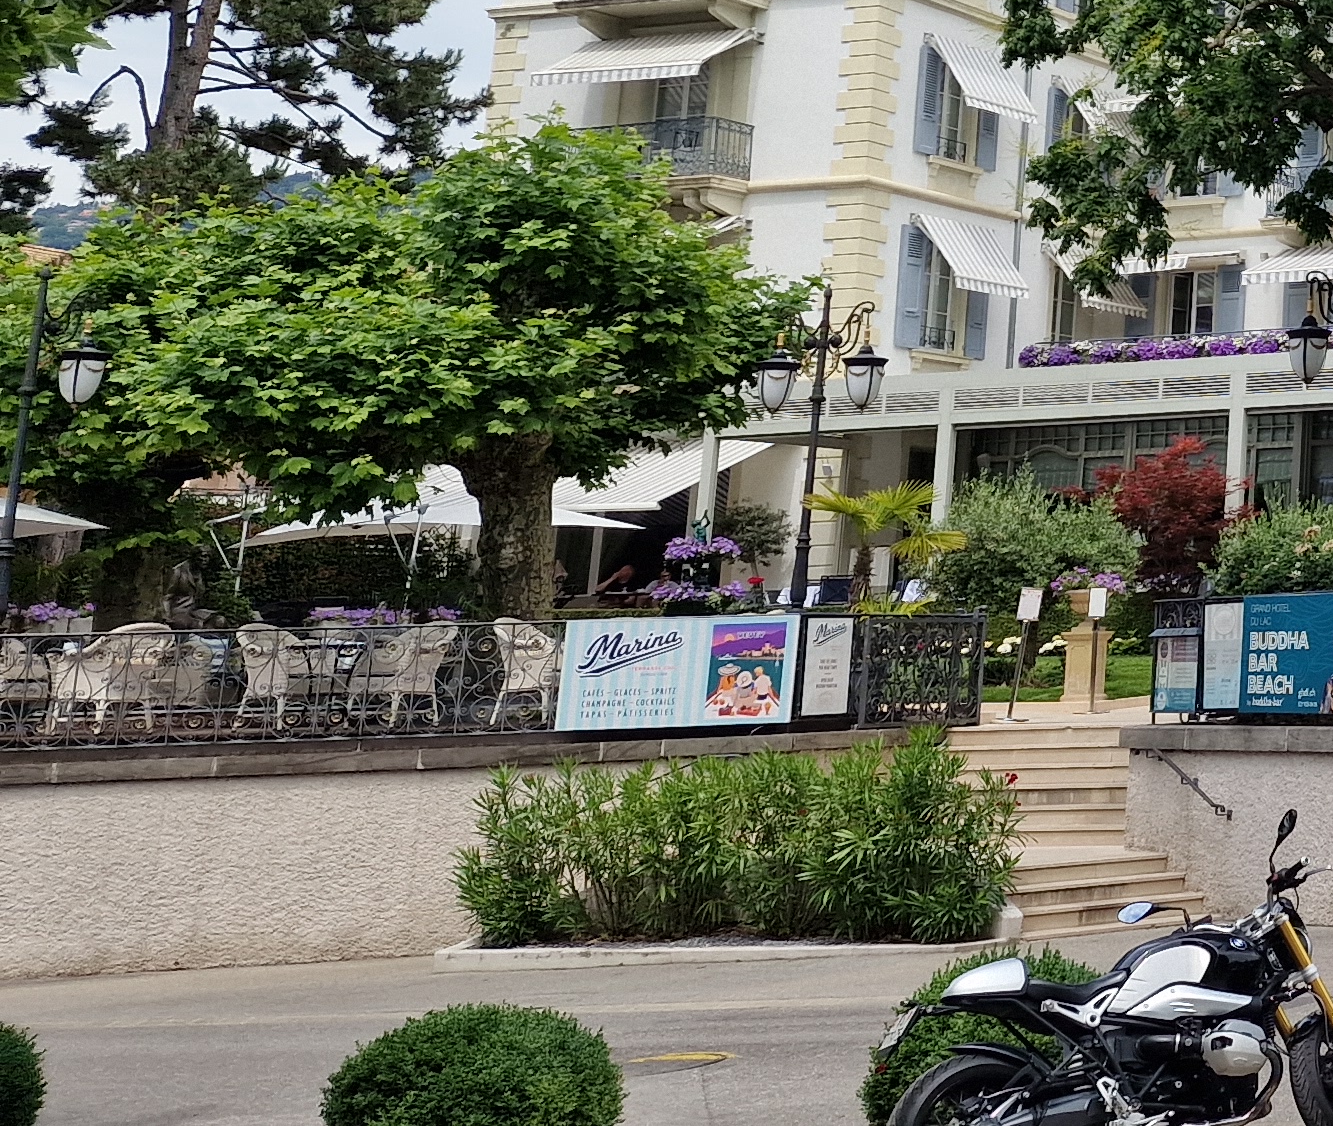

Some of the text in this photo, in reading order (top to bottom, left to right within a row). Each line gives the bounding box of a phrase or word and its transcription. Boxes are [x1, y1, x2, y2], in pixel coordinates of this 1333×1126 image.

[1250, 603, 1291, 613] GRAND HOTEL
[1250, 616, 1272, 626] DU LAC
[1249, 631, 1310, 651] BUDDHA
[576, 631, 683, 674] Marina
[1248, 652, 1278, 672] BAR
[1247, 675, 1294, 694] BEACH
[613, 688, 641, 697] GLACES
[651, 687, 677, 696] SPRITZ
[581, 699, 626, 708] CHAMPAGNE
[635, 698, 675, 706] COCKTAILS
[581, 710, 607, 719] TAPAS
